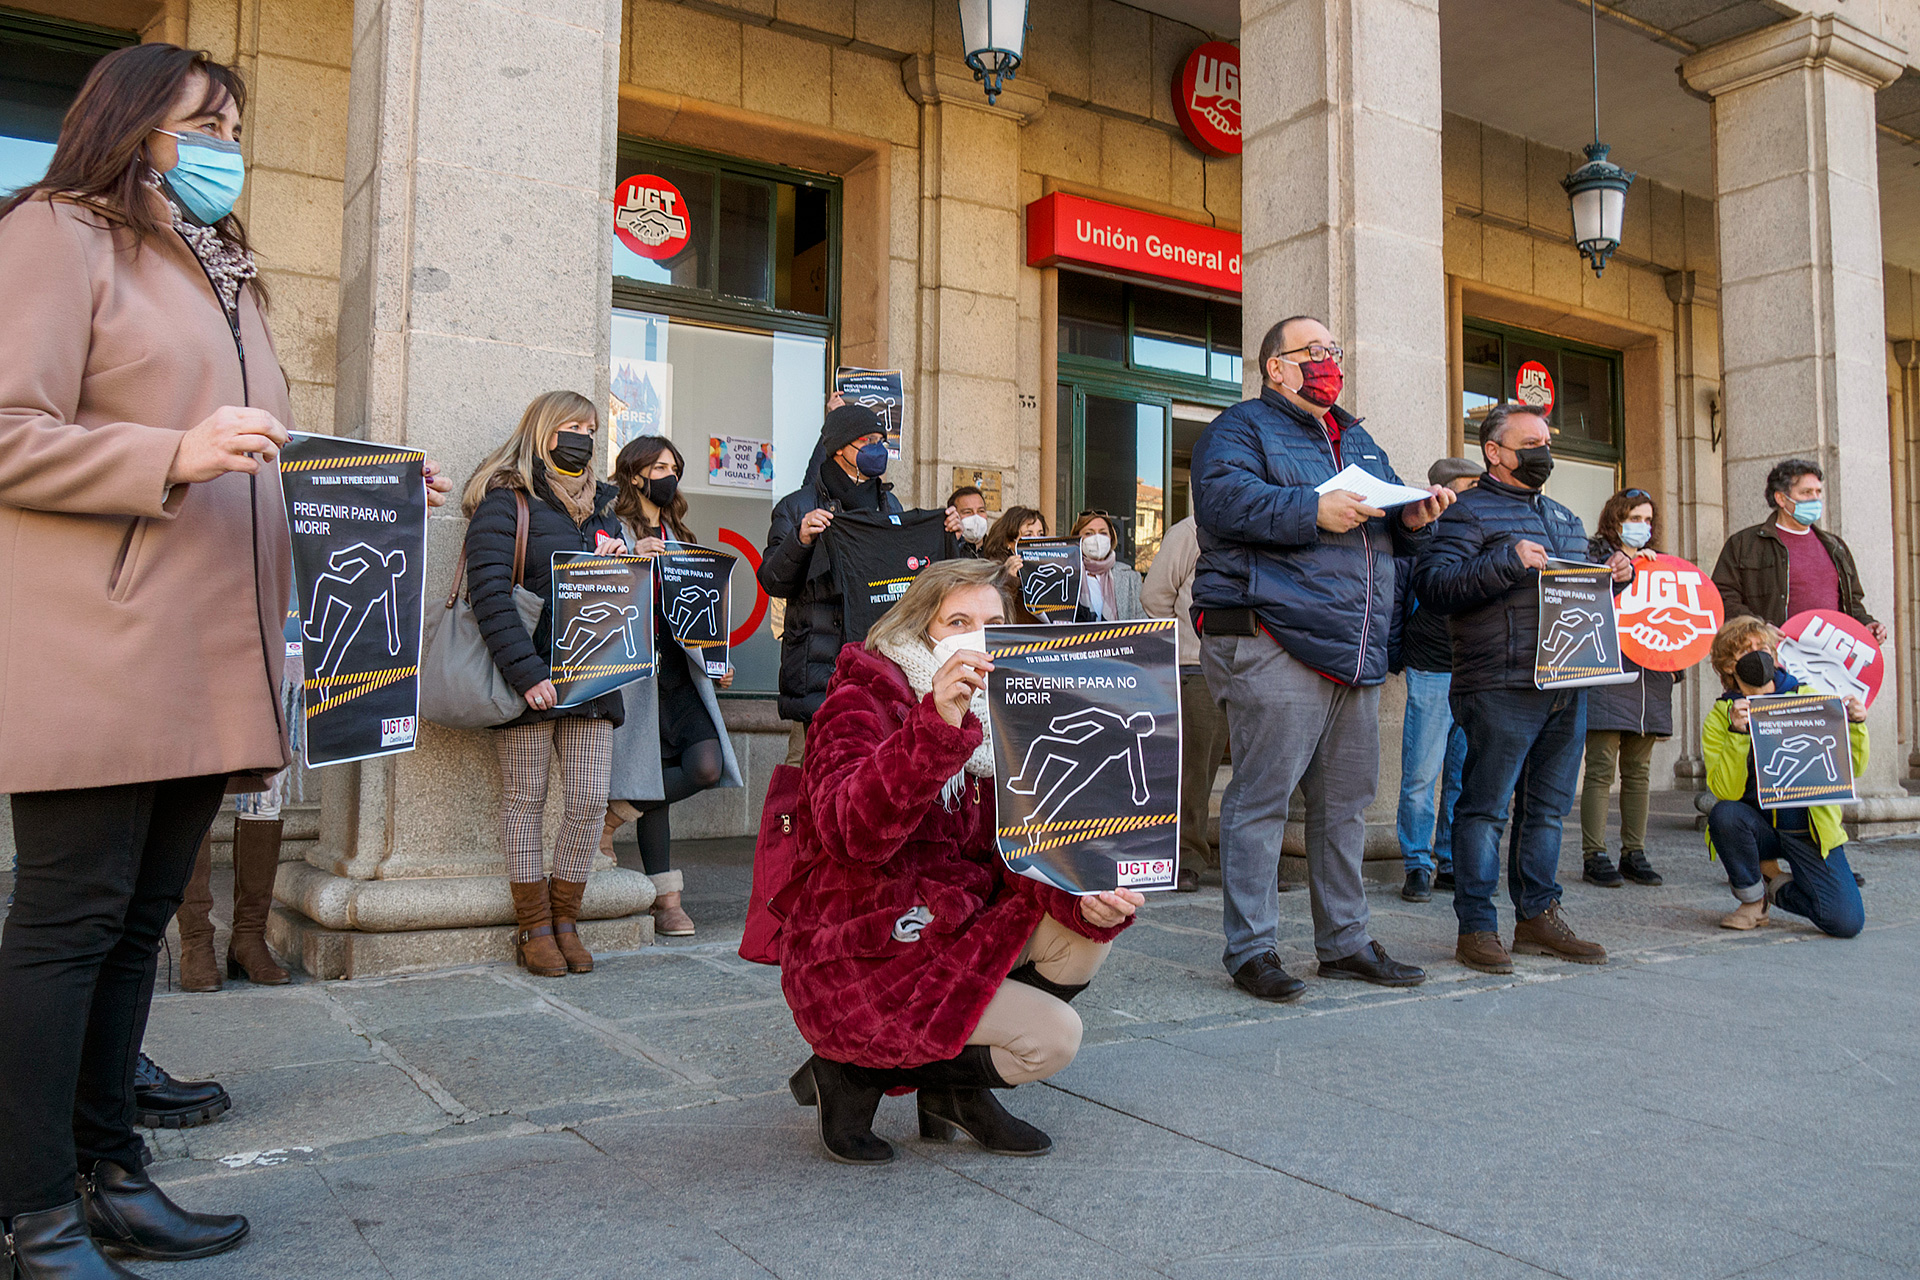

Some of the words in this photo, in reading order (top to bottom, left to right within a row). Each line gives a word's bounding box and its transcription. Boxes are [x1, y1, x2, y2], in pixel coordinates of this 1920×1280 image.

[1195, 54, 1241, 99] UG
[626, 185, 676, 215] UGT
[1076, 218, 1138, 253] Unión
[1145, 235, 1222, 271] General
[1228, 254, 1242, 275] d
[1523, 368, 1546, 388] UGT
[733, 444, 753, 453] ¿POR
[735, 453, 750, 462] QUÉ
[724, 472, 760, 481] IGUALES?
[293, 501, 350, 520] PREVENIR
[351, 507, 380, 522] PARA
[381, 509, 397, 523] NO
[294, 519, 331, 536] MORIR
[663, 566, 690, 576] PREVENIR
[690, 570, 704, 578] PARA
[664, 574, 682, 582] MORIR
[558, 583, 595, 592] PREVENIR
[617, 585, 630, 593] NO
[558, 591, 582, 599] MORIR
[1545, 587, 1571, 598] PREVENIR
[1571, 591, 1586, 600] PARA
[1587, 593, 1596, 601] NO
[1620, 570, 1702, 610] UGT
[1544, 596, 1562, 605] MORIR
[1799, 615, 1876, 678] UGT
[1026, 656, 1035, 664] TU
[1035, 655, 1060, 663] TRABAJO
[1061, 654, 1069, 662] TE
[1069, 652, 1088, 661] PUEDE
[1088, 648, 1111, 659] COSTAR
[1111, 647, 1120, 656] LA
[1120, 646, 1134, 655] VIDA
[1005, 677, 1075, 689] PREVENIR
[1078, 677, 1115, 689] PARA
[1117, 677, 1137, 689] NO
[1005, 692, 1051, 705] MORIR
[383, 719, 402, 735] UGT
[1758, 720, 1793, 728] PREVENIR
[1794, 719, 1813, 727] PARA
[1814, 718, 1826, 727] NO
[1118, 861, 1149, 875] UGT
